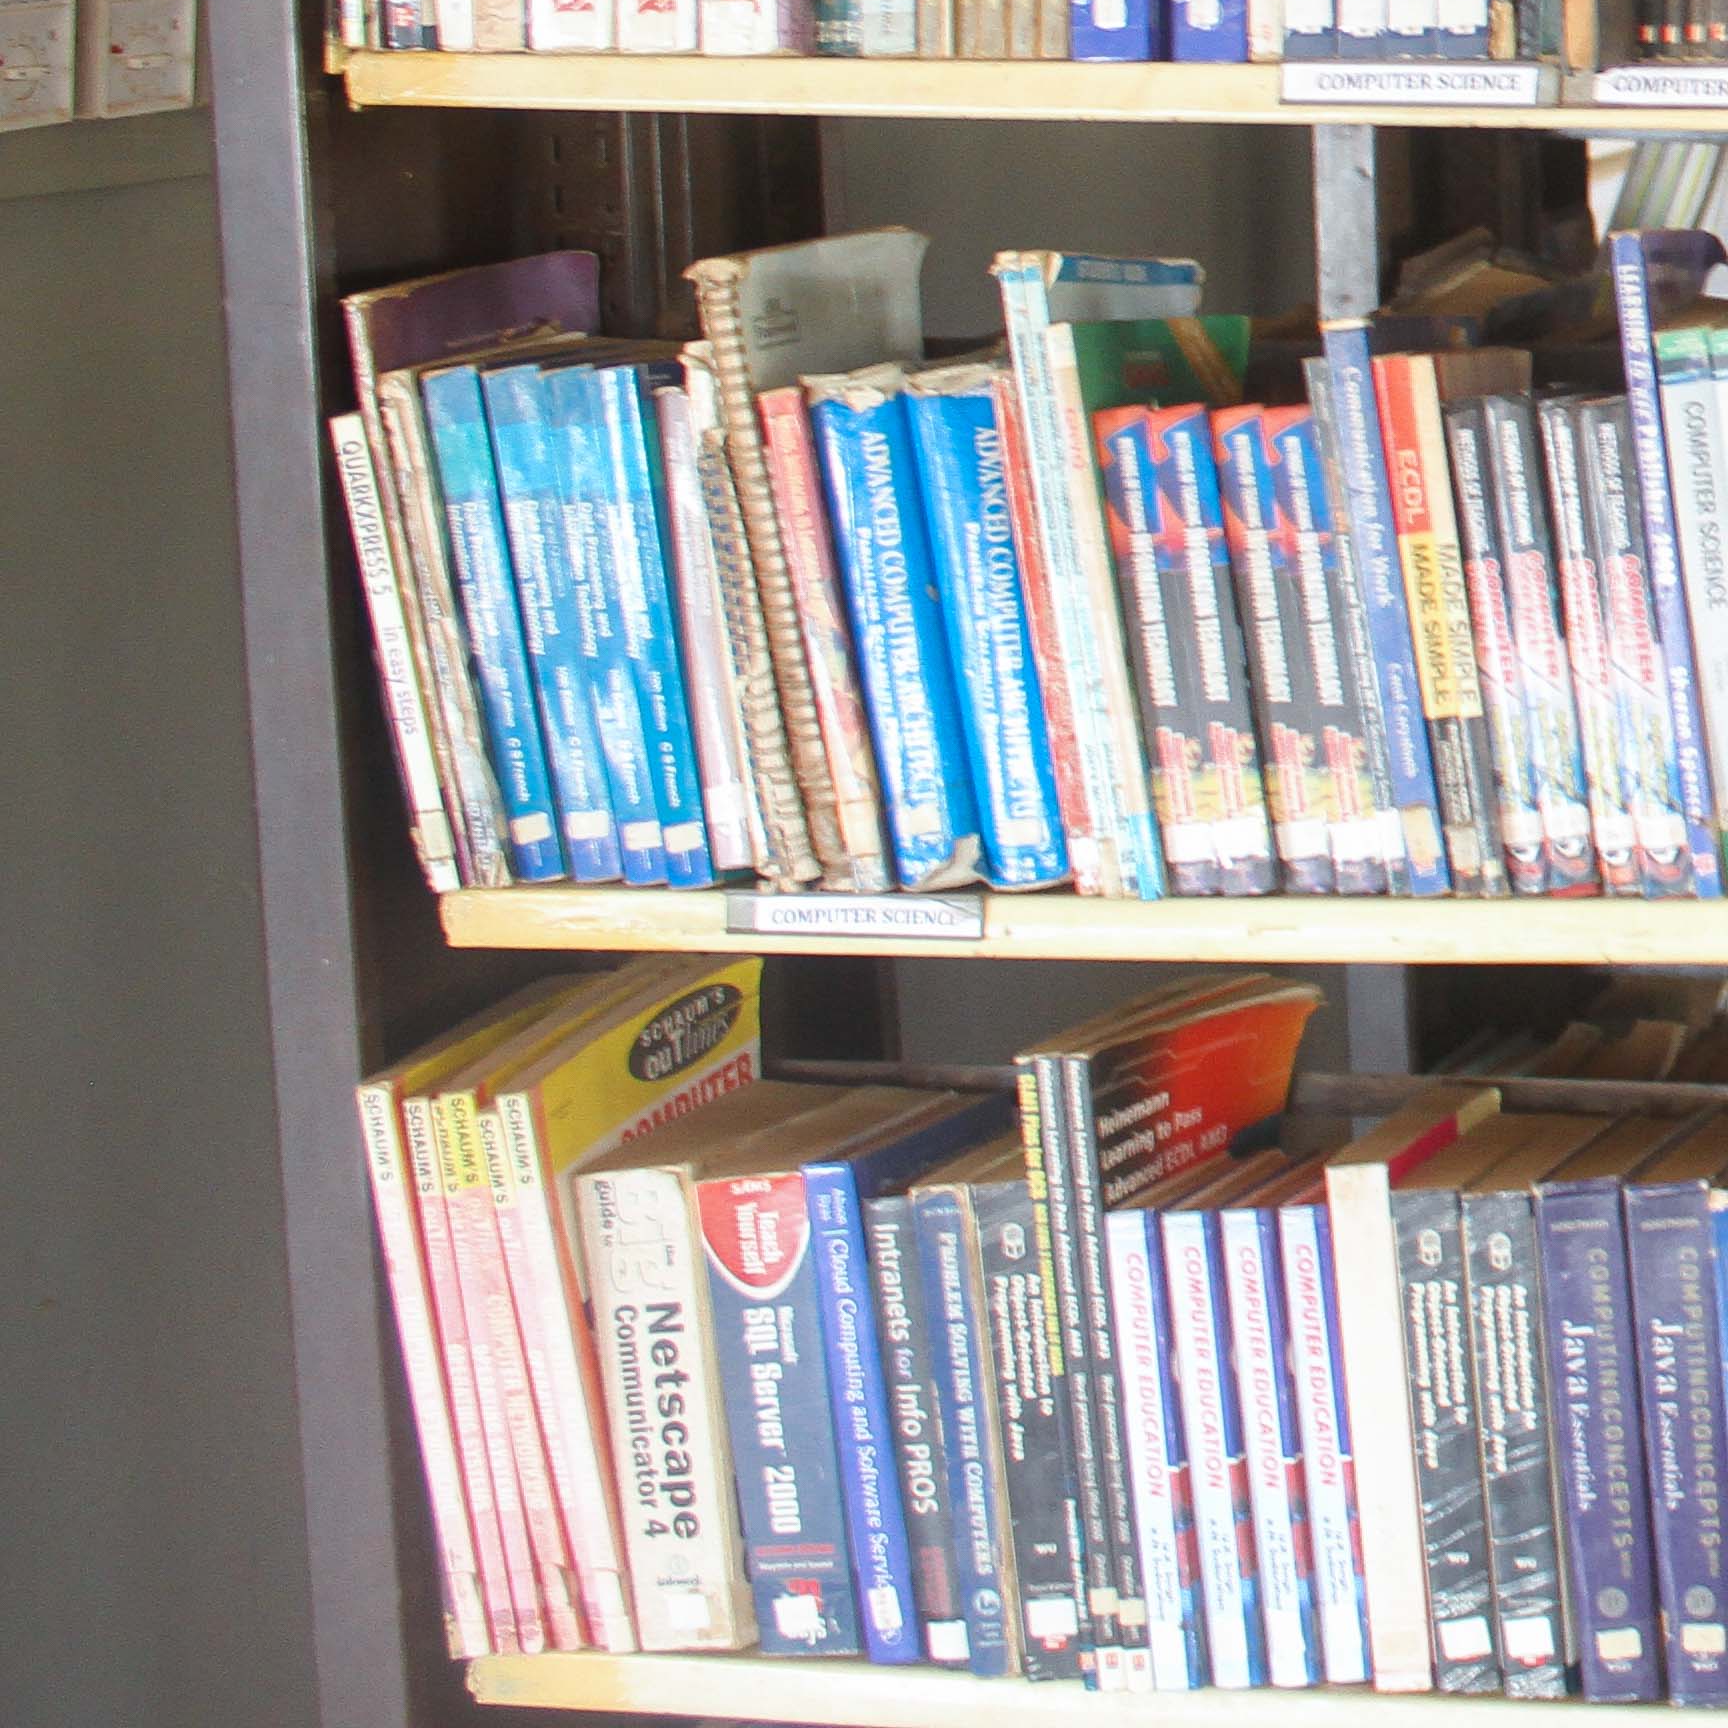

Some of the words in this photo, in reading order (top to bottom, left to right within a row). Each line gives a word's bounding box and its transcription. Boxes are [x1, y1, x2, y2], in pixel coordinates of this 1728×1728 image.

[1317, 73, 1433, 92] COMPUTER
[1437, 73, 1520, 93] SCIENCE
[1613, 75, 1728, 97] COMPUTER
[1341, 365, 1383, 519] Communication
[1610, 262, 1652, 355] LEARNING
[1650, 533, 1680, 588] 2000
[1681, 399, 1719, 514] COMPUTER
[860, 428, 901, 548] ADVANCED
[972, 424, 1011, 541] ADVANCED
[1393, 448, 1426, 525] ECDL
[876, 549, 920, 675] COMPUTER
[980, 545, 1024, 671] COMPUTER
[1411, 542, 1438, 614] MADE
[1436, 542, 1466, 617] MADE
[377, 646, 408, 688] easy
[1421, 616, 1450, 706] SIMPLE
[1447, 619, 1479, 703] SIMPLE
[390, 689, 422, 736] steps
[772, 907, 877, 925] COMPUTER
[362, 1092, 397, 1181] SCHAUM'S
[406, 1104, 434, 1192] SCHAUM'S
[450, 1096, 479, 1184] SCHAUM'S
[478, 1117, 507, 1204] SCHAUM'S
[504, 1098, 533, 1185] SCHAUM'S
[593, 1178, 617, 1229] guide
[756, 1209, 783, 1263] Teach
[826, 1238, 854, 1294] Cloud
[872, 1221, 916, 1341] Intranets
[937, 1231, 966, 1320] PROBLEM
[1180, 1245, 1212, 1361] COMPUTER
[1236, 1245, 1268, 1360] COMPUTER
[1292, 1243, 1325, 1360] COMPUTER
[743, 1307, 777, 1354] SQL
[831, 1297, 867, 1403] Computing
[1122, 1253, 1155, 1369] COMPUTER
[1585, 1247, 1624, 1407] COMPUTING
[1649, 1317, 1688, 1394] Java
[1674, 1245, 1713, 1405] COMPUTING
[1557, 1317, 1600, 1396] Java
[610, 1302, 665, 1510] Communicator
[642, 1517, 671, 1539] 4
[641, 1300, 708, 1541] Netscape
[750, 1362, 785, 1450] Server
[848, 1405, 872, 1441] and
[896, 1382, 927, 1437] Info
[1136, 1373, 1169, 1496] EDUCATION
[1193, 1366, 1226, 1488] EDUCATION
[1249, 1366, 1282, 1488] EDUCATION
[1306, 1363, 1339, 1486] EDUCATION
[764, 1464, 800, 1535] 2000
[852, 1445, 884, 1529] Software
[901, 1441, 938, 1516] PROS
[1596, 1405, 1636, 1560] CONCEPTS
[1685, 1403, 1724, 1560] CONCEPTS
